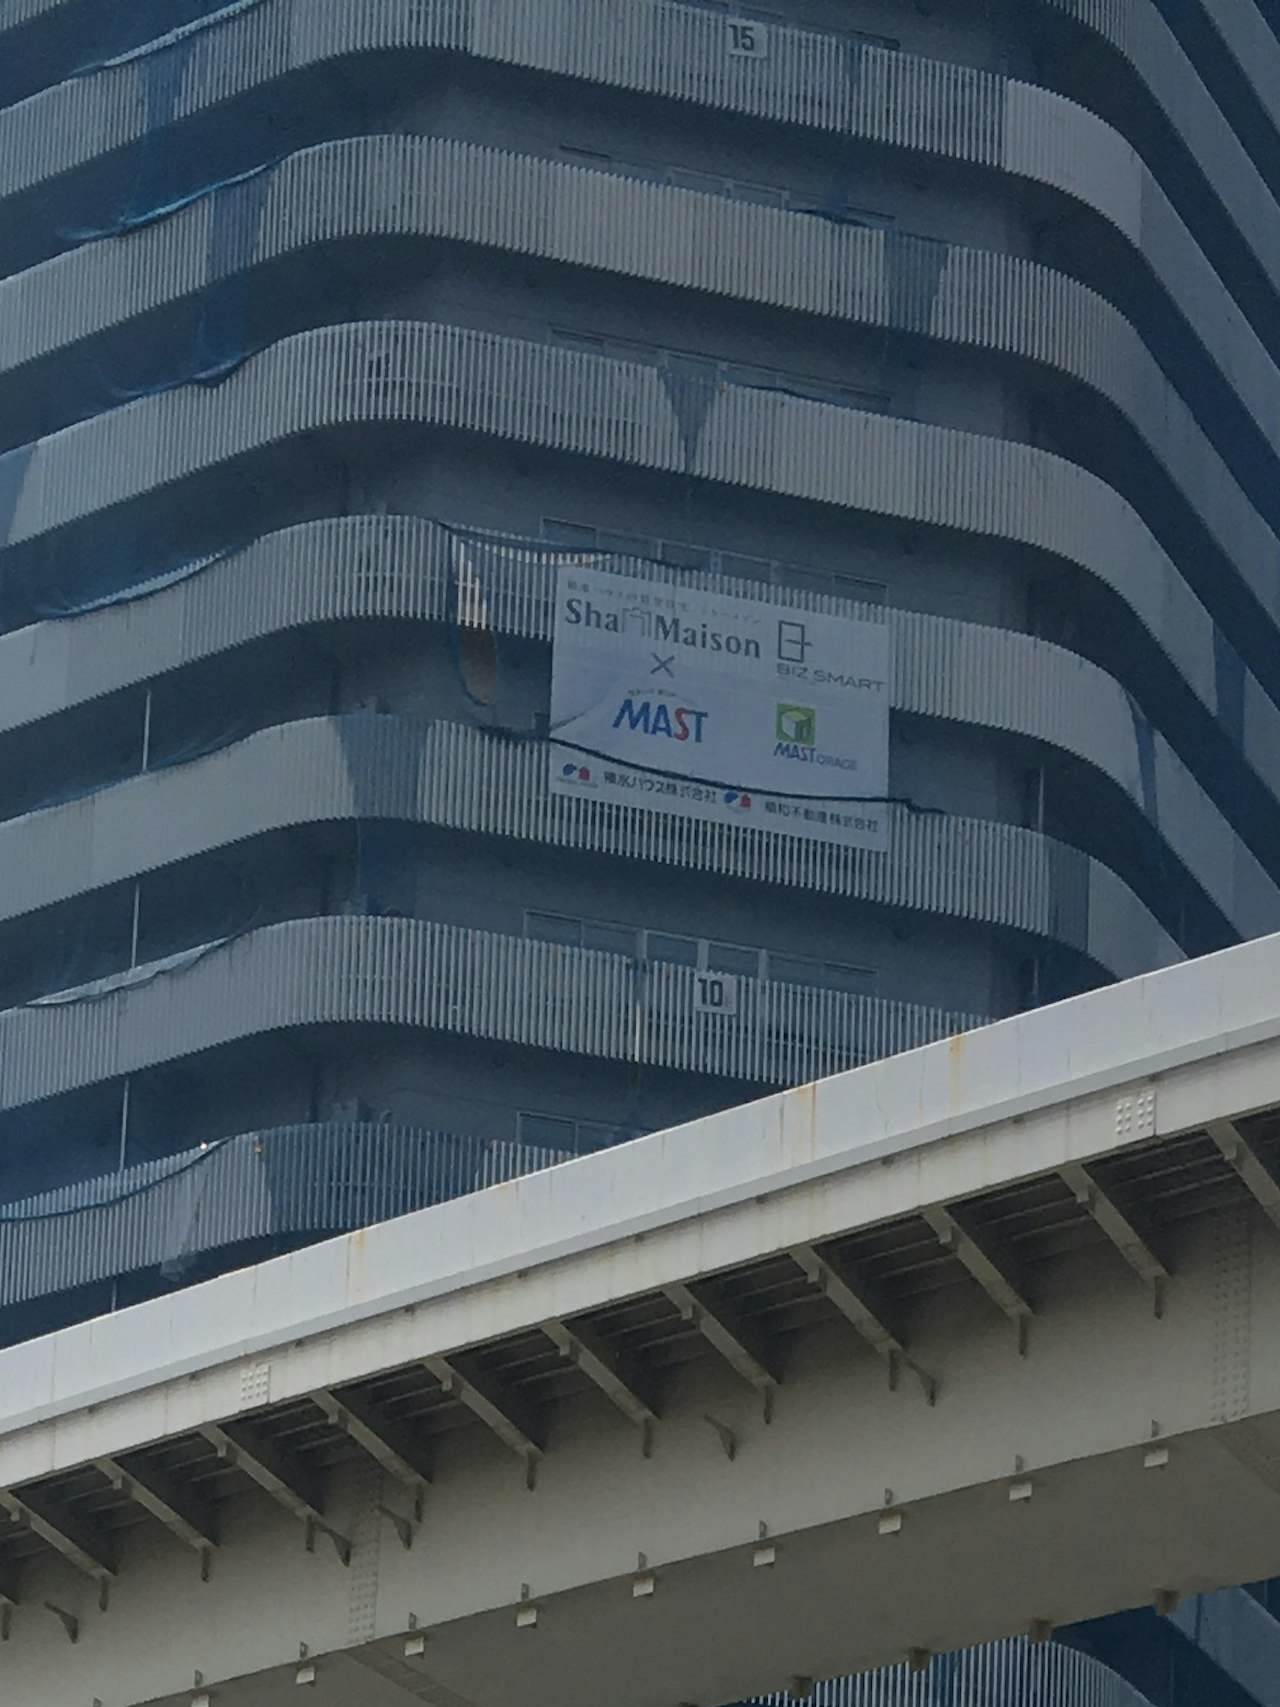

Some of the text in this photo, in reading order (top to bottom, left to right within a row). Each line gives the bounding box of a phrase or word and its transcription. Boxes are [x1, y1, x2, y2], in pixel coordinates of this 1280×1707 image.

[777, 663, 885, 692] BIZ SMART
[613, 699, 708, 743] MAST
